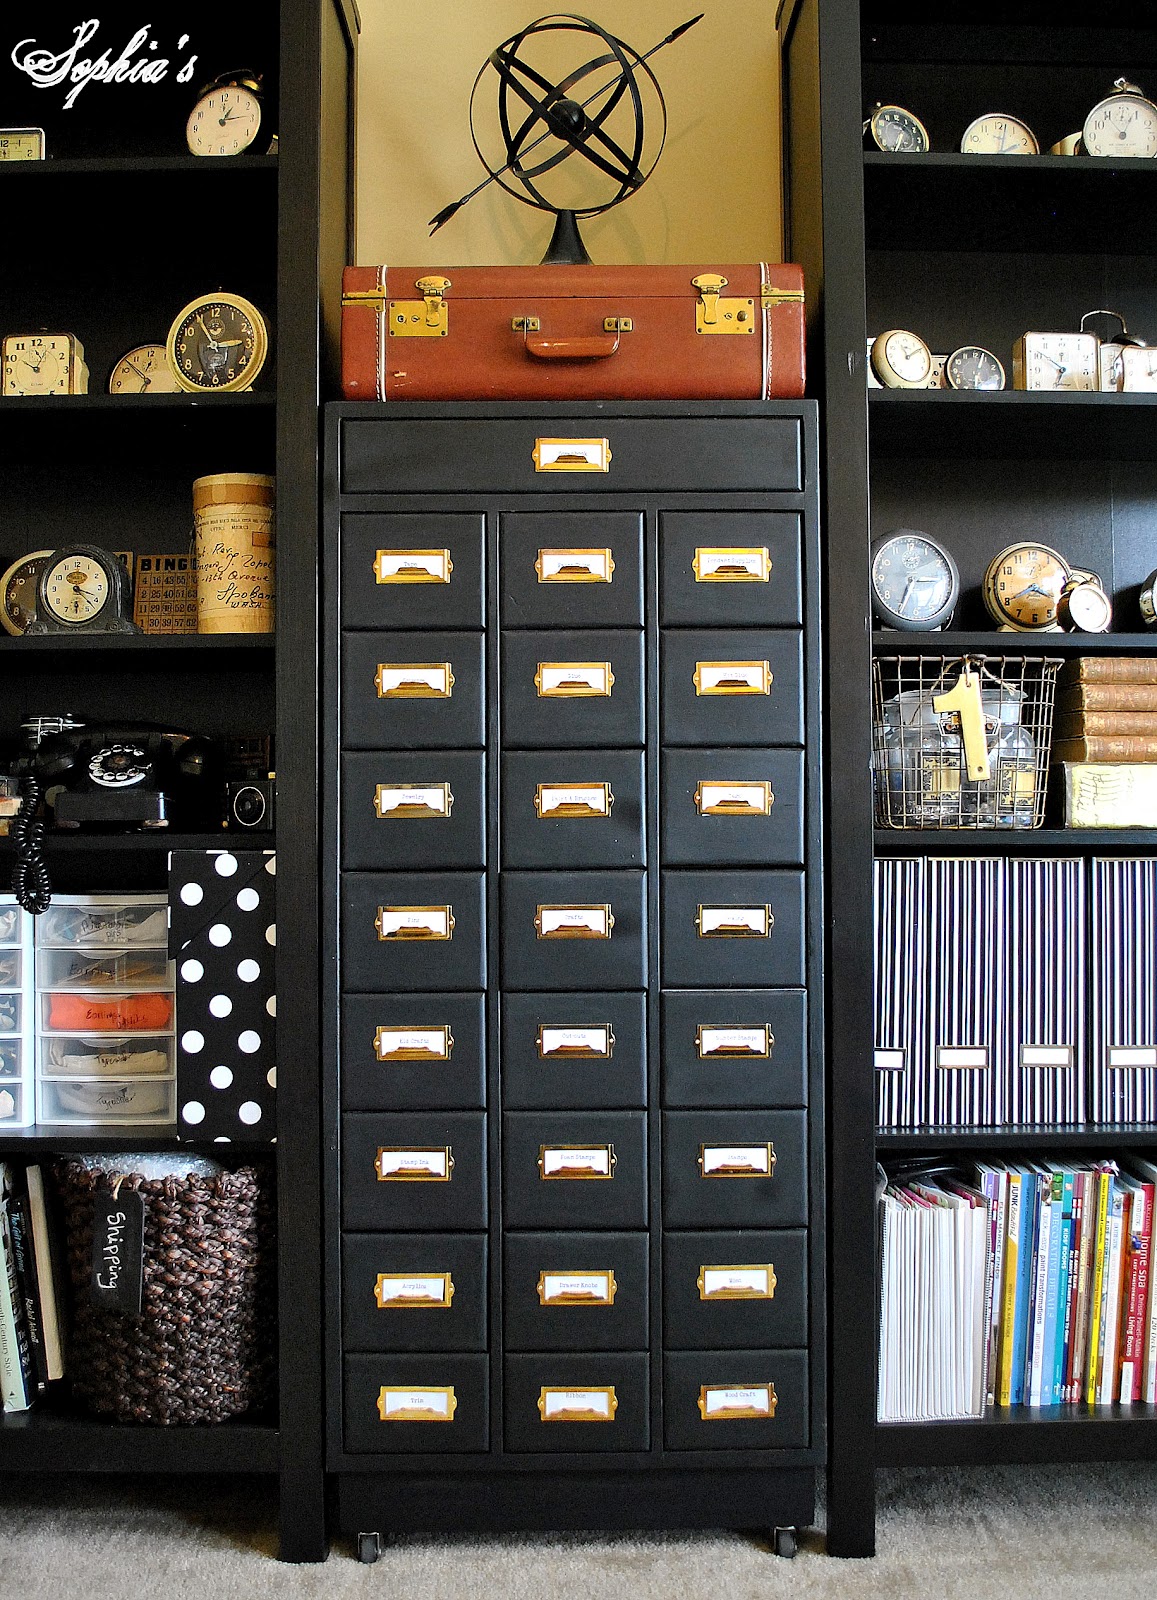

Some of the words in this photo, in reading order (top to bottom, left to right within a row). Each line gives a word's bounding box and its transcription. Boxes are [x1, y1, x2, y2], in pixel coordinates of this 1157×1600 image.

[1136, 110, 1138, 120] 1
[995, 122, 1002, 130] 12
[1012, 126, 1015, 134] 1
[1095, 120, 1104, 130] 10
[1144, 120, 1152, 130] 2
[970, 134, 979, 142] 10
[1022, 138, 1028, 146] 2
[1088, 132, 1096, 142] 9
[0, 140, 8, 148] 12
[211, 308, 220, 318] 12
[232, 312, 234, 320] 1
[184, 326, 194, 336] 10
[242, 322, 247, 332] 2
[16, 342, 25, 350] 11
[31, 338, 42, 346] 12
[246, 338, 252, 349] 3
[180, 344, 186, 354] 9
[6, 354, 18, 362] 10
[238, 355, 247, 366] 4
[185, 358, 192, 370] 8
[63, 366, 69, 374] 3
[228, 368, 235, 379] 5
[198, 372, 204, 382] 7
[212, 374, 219, 384] 6
[10, 380, 16, 388] 8
[892, 547, 898, 556] 11
[907, 543, 914, 552] 12
[924, 548, 928, 556] 1
[1014, 555, 1022, 564] 11
[1028, 551, 1038, 560] 12
[1046, 556, 1050, 564] 1
[1003, 566, 1012, 575] 10
[880, 574, 885, 583] 9
[1000, 582, 1006, 591] 9
[884, 590, 890, 600] 8
[1004, 598, 1010, 606] 8
[913, 608, 919, 616] 6
[1016, 608, 1022, 618] 7
[1046, 609, 1052, 618] 5
[1032, 614, 1038, 623] 6
[933, 672, 990, 782] 1
[11, 1213, 20, 1226] The
[1050, 1212, 1060, 1274] DECORATIVE
[97, 1211, 127, 1290] Shipping
[1140, 1236, 1150, 1266] home
[1138, 1270, 1147, 1288] spa
[1036, 1274, 1046, 1324] transformations
[1048, 1277, 1056, 1318] DETAILS
[1126, 1316, 1136, 1334] Living
[1126, 1336, 1134, 1356] Rooms
[4, 1358, 12, 1377] Style
